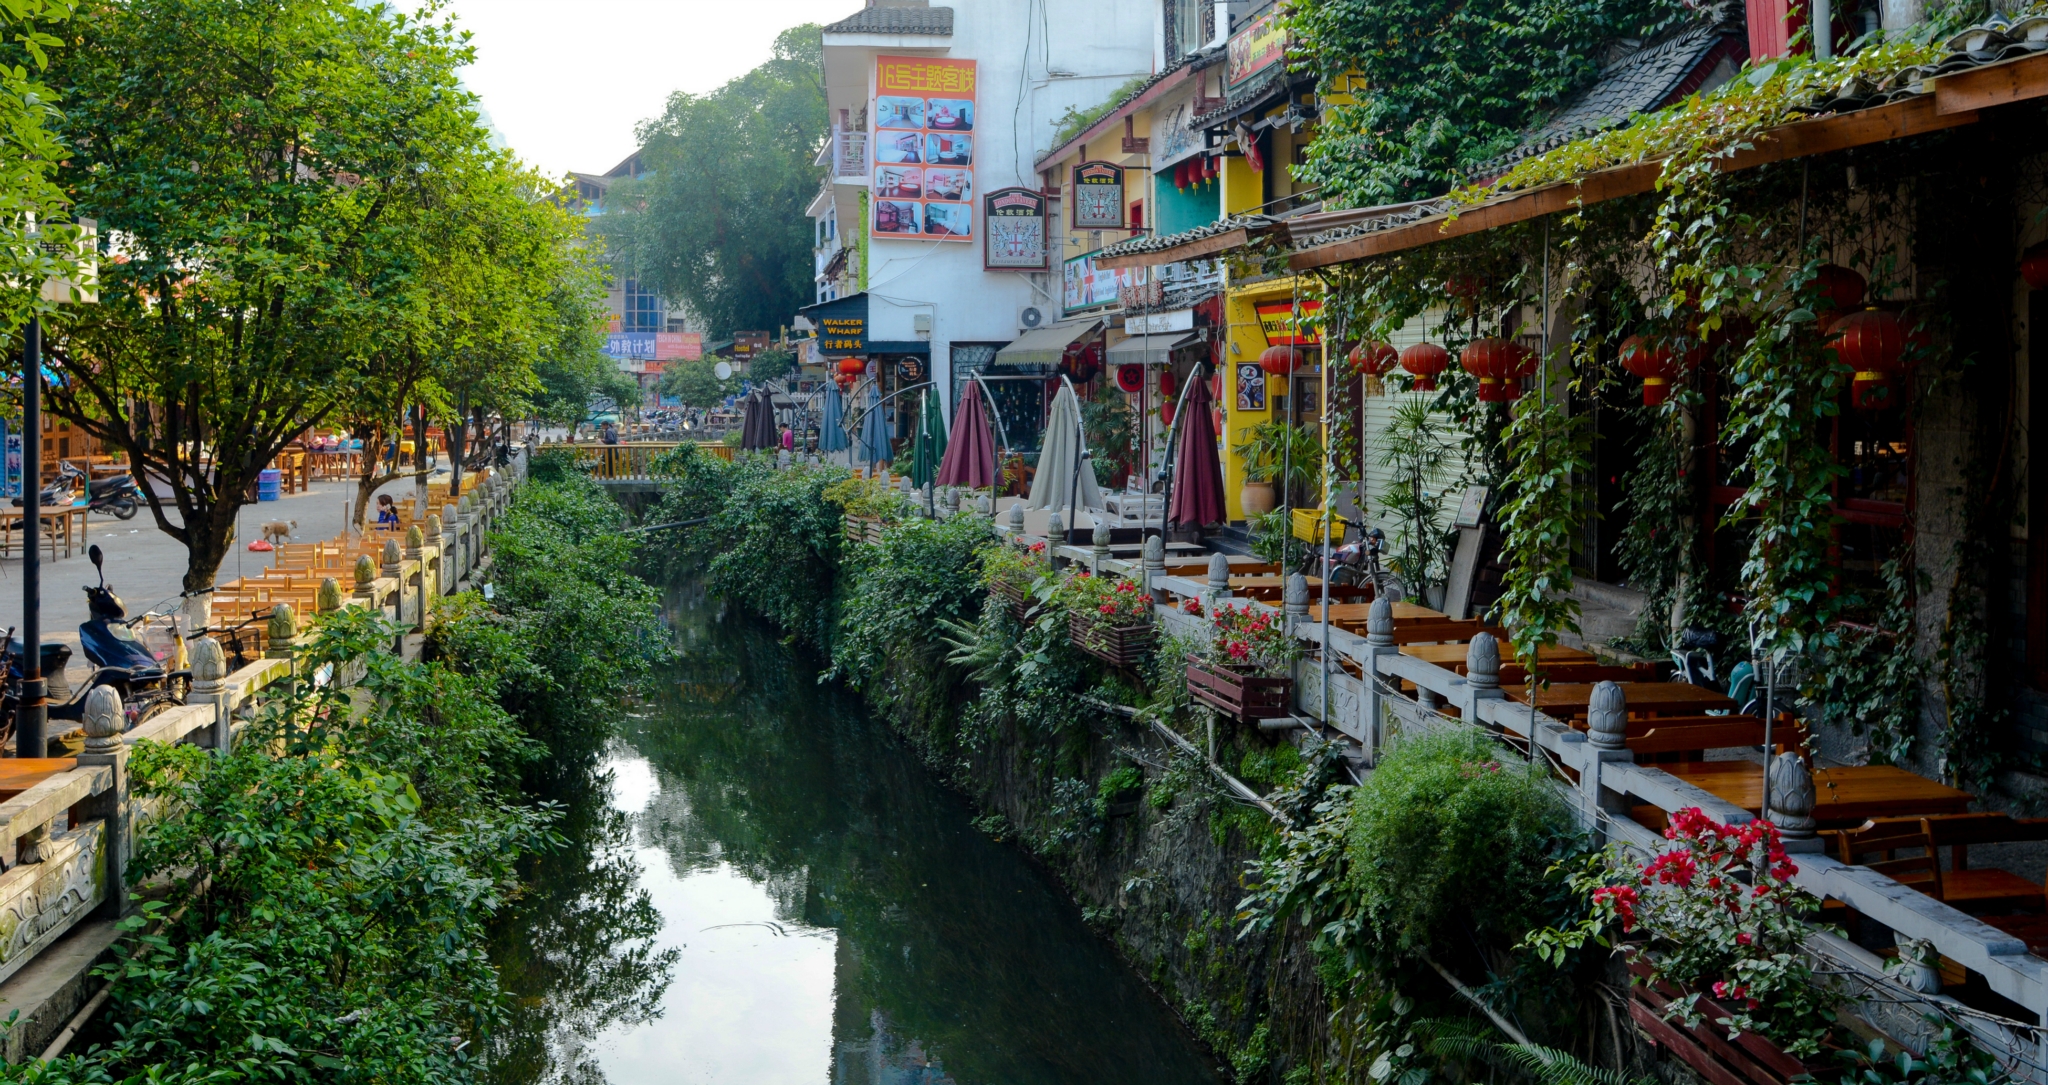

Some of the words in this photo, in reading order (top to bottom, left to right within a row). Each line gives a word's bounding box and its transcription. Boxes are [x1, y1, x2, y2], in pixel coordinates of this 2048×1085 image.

[878, 63, 975, 92] 16号主题客栈
[994, 197, 1016, 207] LONDON
[1016, 197, 1036, 207] TAVERN
[827, 327, 863, 335] WHARF
[734, 344, 750, 352] Hostel
[825, 340, 862, 349] 行者码头
